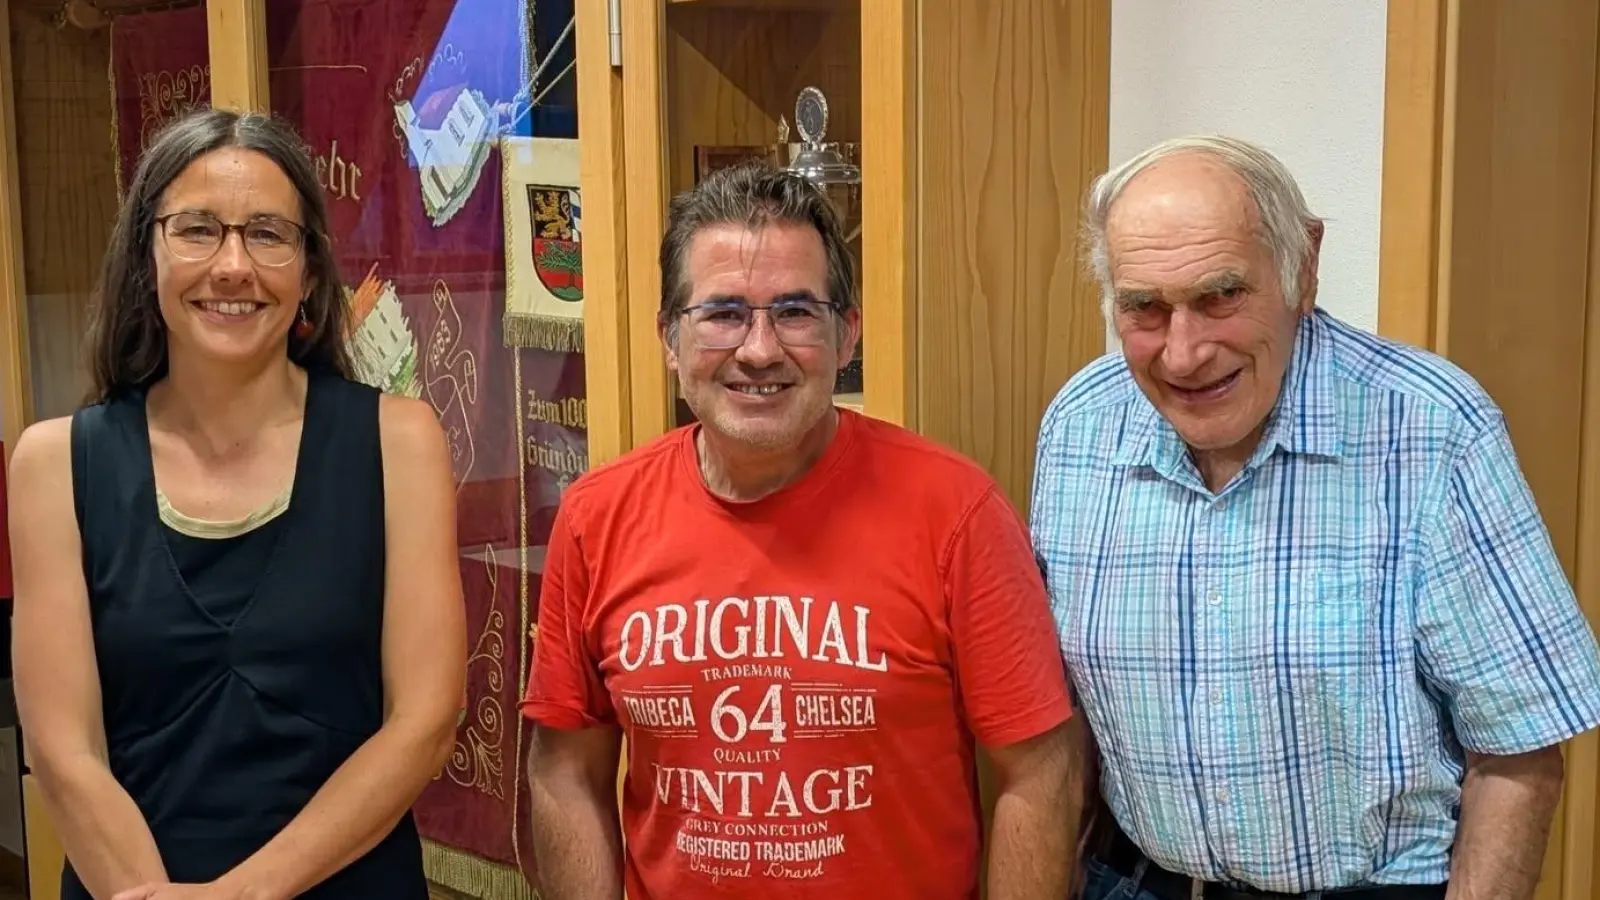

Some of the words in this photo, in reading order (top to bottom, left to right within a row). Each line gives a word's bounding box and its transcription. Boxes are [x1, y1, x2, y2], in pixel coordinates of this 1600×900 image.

[527, 389, 560, 424] Zum
[618, 596, 888, 672] ORIGINAL
[701, 664, 793, 682] TRADEMARK
[623, 696, 696, 727] TRIBECA
[710, 684, 787, 743] 64
[795, 694, 876, 726] CHELSEA
[713, 747, 781, 764] QUALITY
[652, 763, 874, 818] VINTAGE
[686, 818, 721, 834] GREY
[725, 819, 829, 837] CONNECTION
[676, 831, 750, 861] REGISTERED
[754, 834, 845, 862] TRADEMARK
[690, 855, 752, 884] Original
[763, 859, 824, 879] Brand
